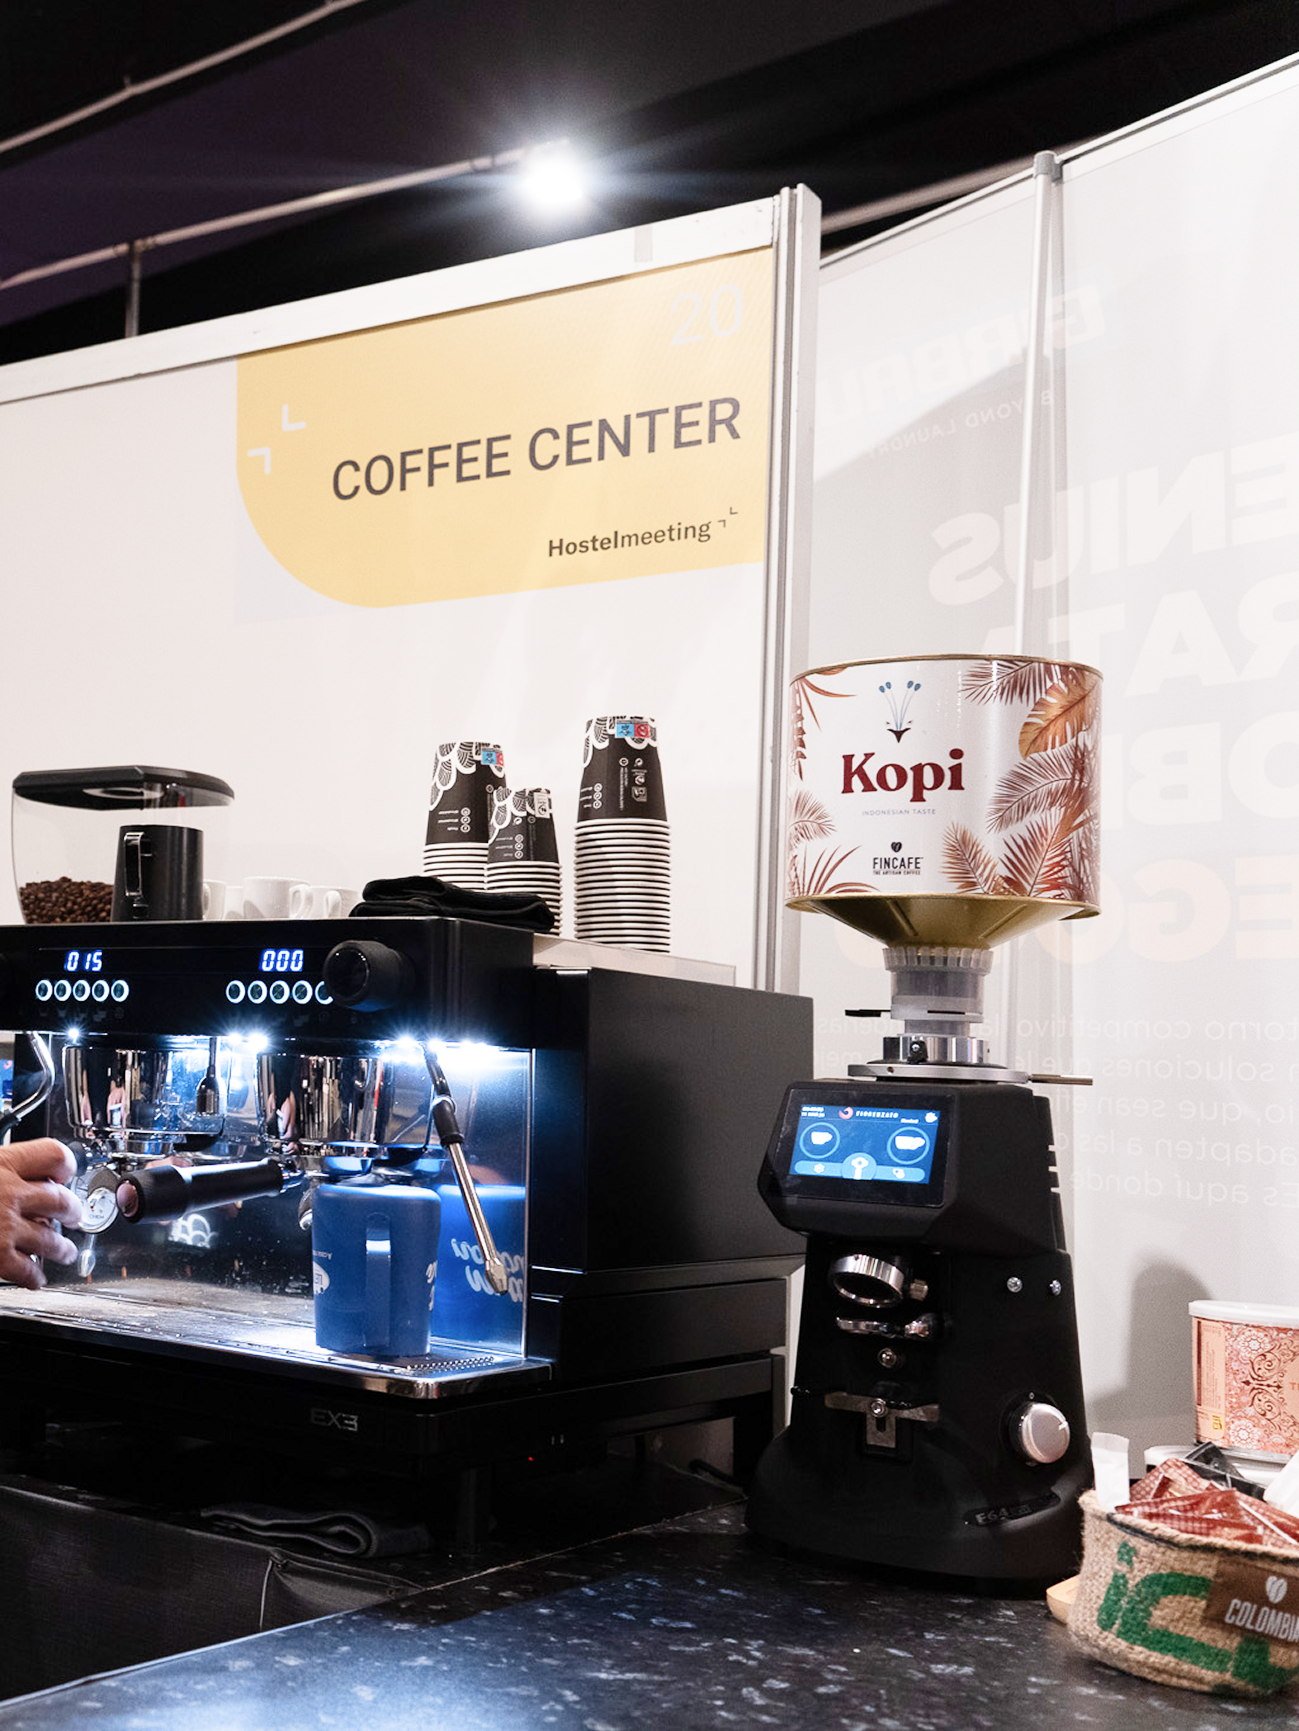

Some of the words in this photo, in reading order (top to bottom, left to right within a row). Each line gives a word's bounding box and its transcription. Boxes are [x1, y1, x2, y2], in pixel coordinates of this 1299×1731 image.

[669, 284, 744, 347] 20
[332, 434, 512, 501] COFFEE
[528, 396, 742, 472] CENTER
[547, 520, 712, 558] Hostelmeeting
[841, 747, 966, 803] Kopi
[861, 808, 910, 817] INDONESIAN
[912, 807, 937, 815] TASTE
[872, 856, 921, 870] FINCAFE
[64, 950, 102, 972] 015
[259, 949, 303, 972] 000
[310, 1408, 359, 1432] EX3
